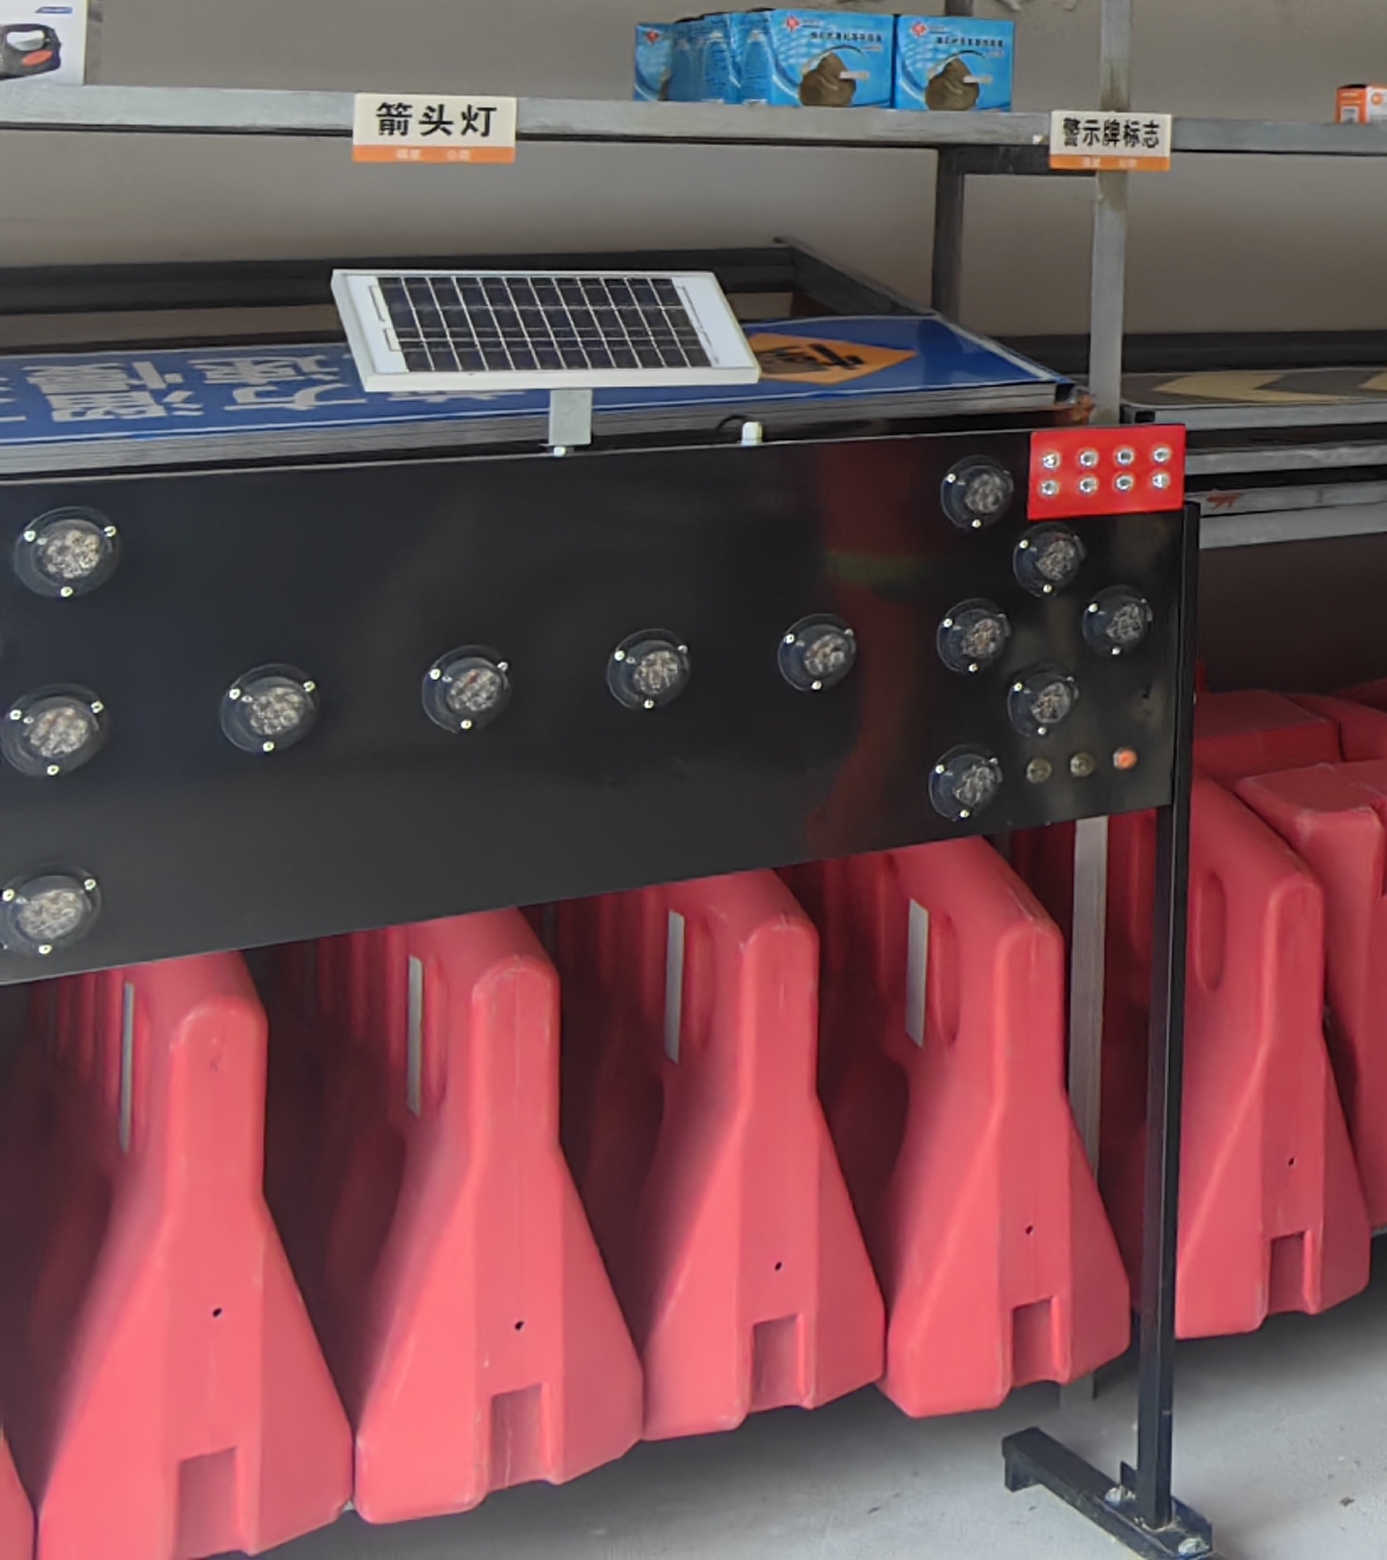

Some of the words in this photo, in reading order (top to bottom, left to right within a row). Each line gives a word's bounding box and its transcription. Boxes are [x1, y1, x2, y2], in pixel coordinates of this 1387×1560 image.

[375, 102, 498, 138] 箭头灯
[1062, 117, 1160, 149] 警示牌标志
